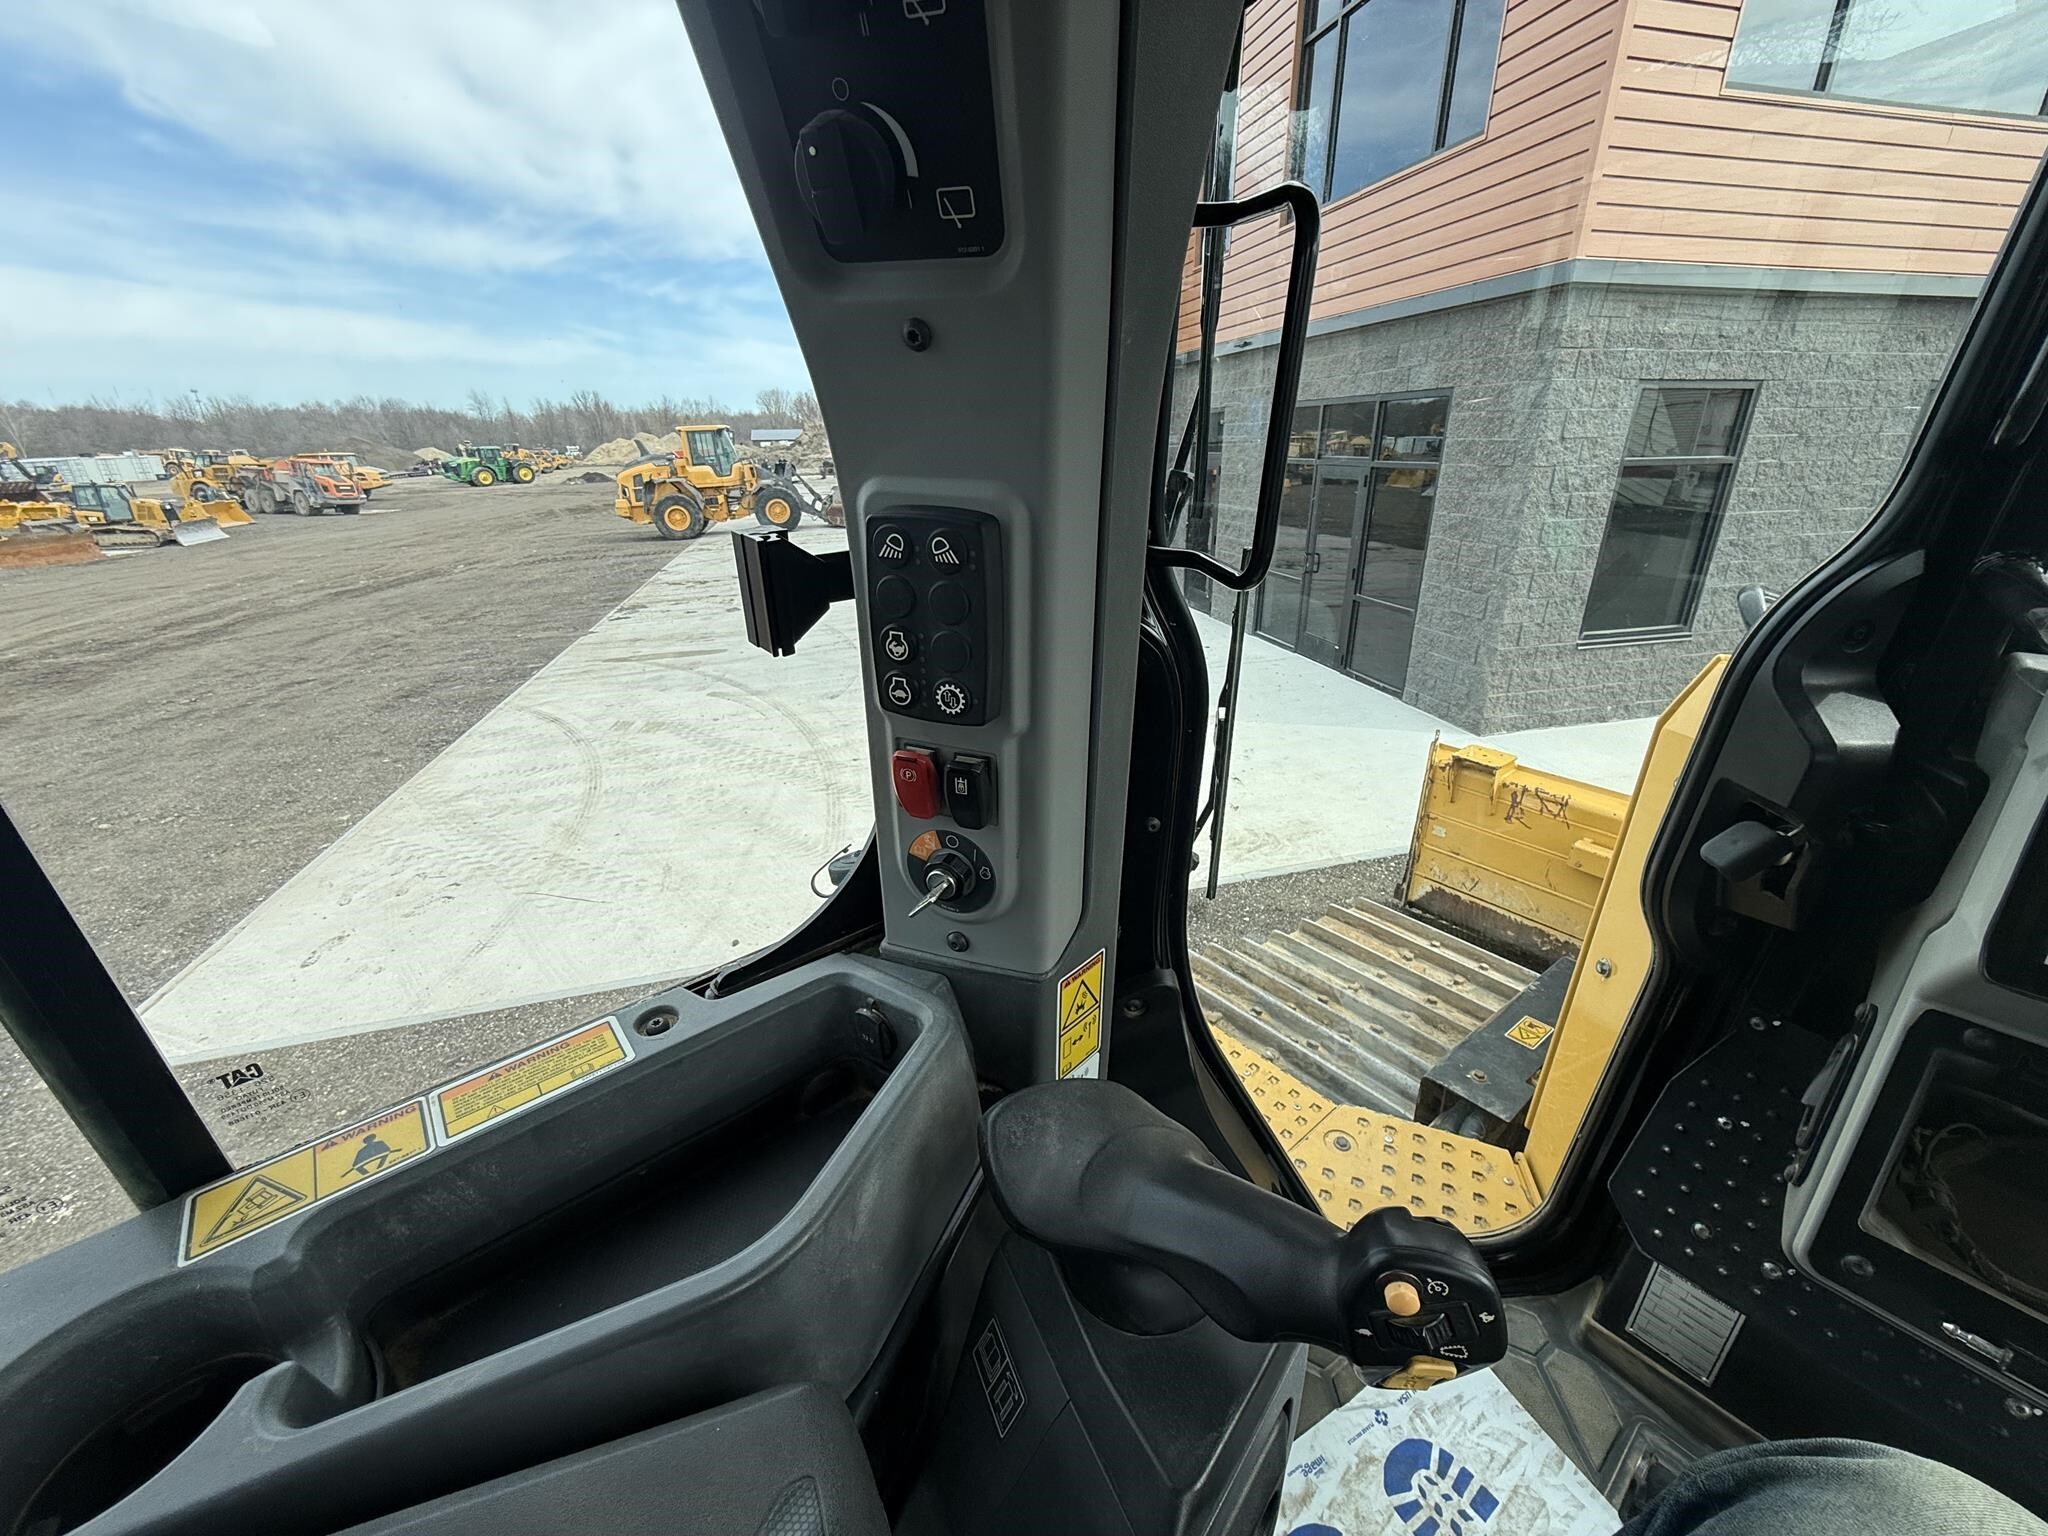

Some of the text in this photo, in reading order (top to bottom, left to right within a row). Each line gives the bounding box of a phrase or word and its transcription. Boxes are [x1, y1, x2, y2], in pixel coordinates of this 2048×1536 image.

[905, 770, 912, 778] P
[504, 1041, 571, 1074] WARNING
[342, 1105, 417, 1141] WARNING
[1397, 1390, 1412, 1405] USA
[1300, 1453, 1326, 1478] image
